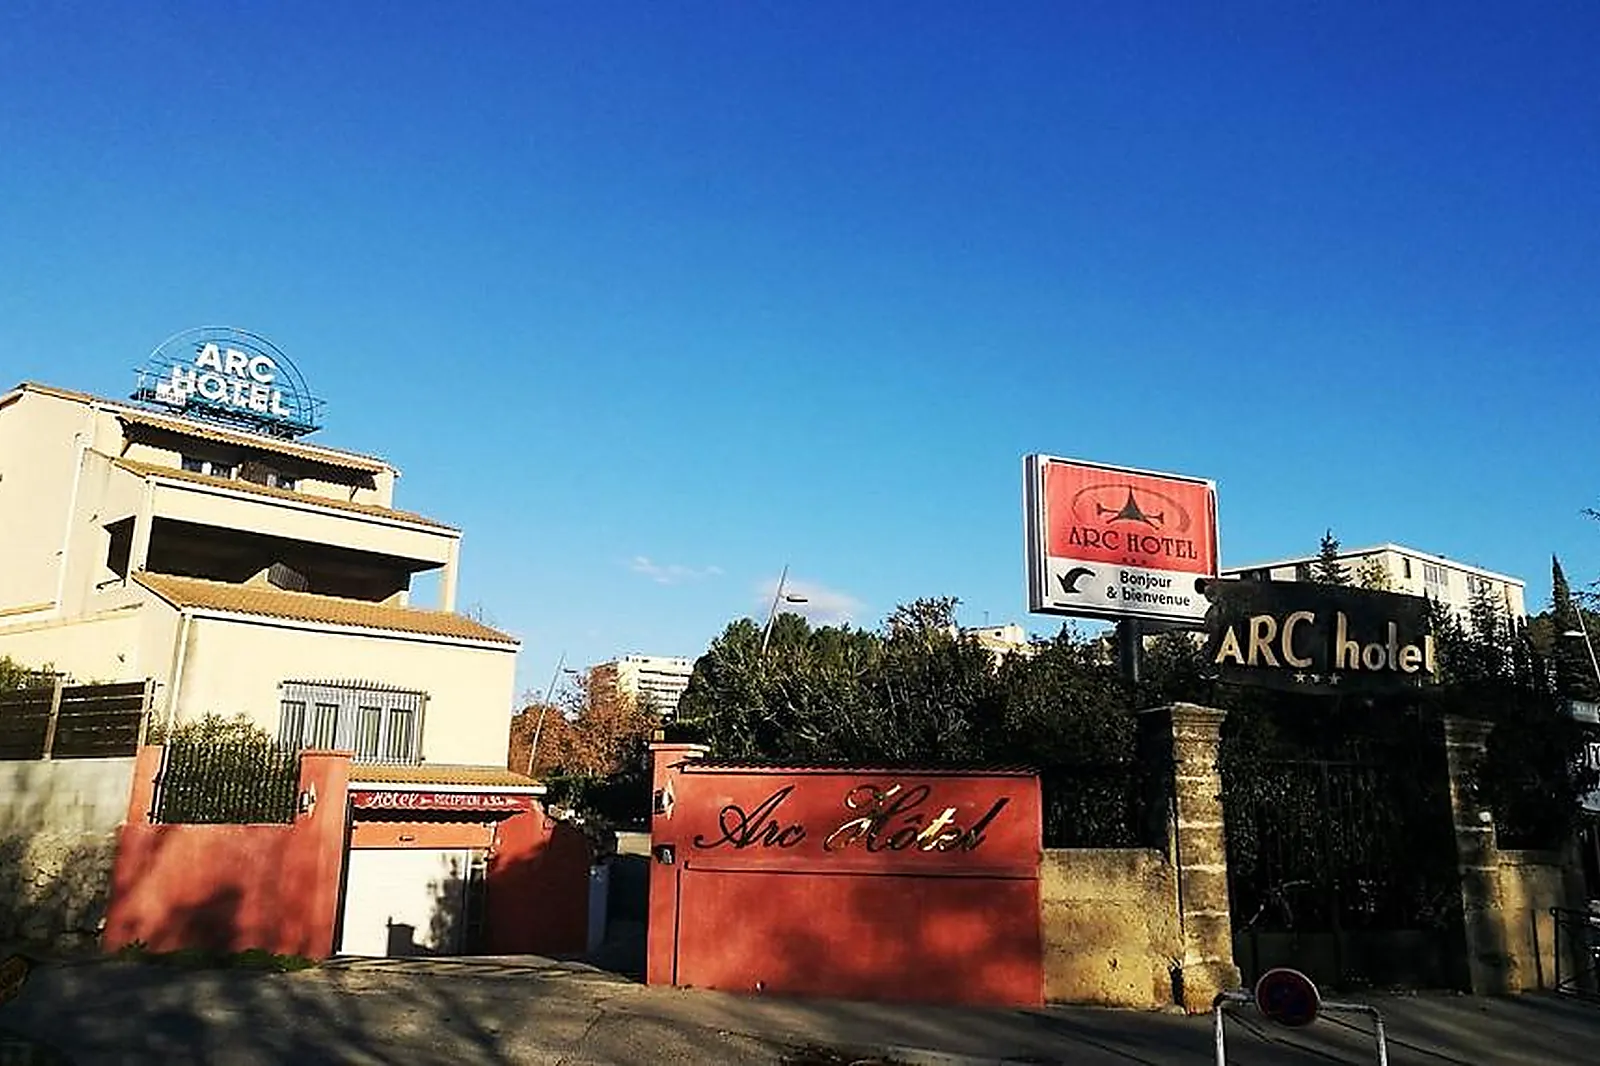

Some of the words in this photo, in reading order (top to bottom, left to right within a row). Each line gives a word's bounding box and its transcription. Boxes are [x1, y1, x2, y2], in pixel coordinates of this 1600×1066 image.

[195, 342, 277, 383] ARC
[171, 364, 290, 417] HOTEL
[1069, 526, 1119, 551] ARC
[1127, 532, 1198, 560] HOTEL
[1106, 585, 1118, 600] &
[1122, 586, 1191, 607] bienvenue
[1119, 570, 1173, 590] Bonjour
[1214, 610, 1316, 668] ARC
[1335, 610, 1438, 674] hotel
[693, 785, 806, 850] Arc
